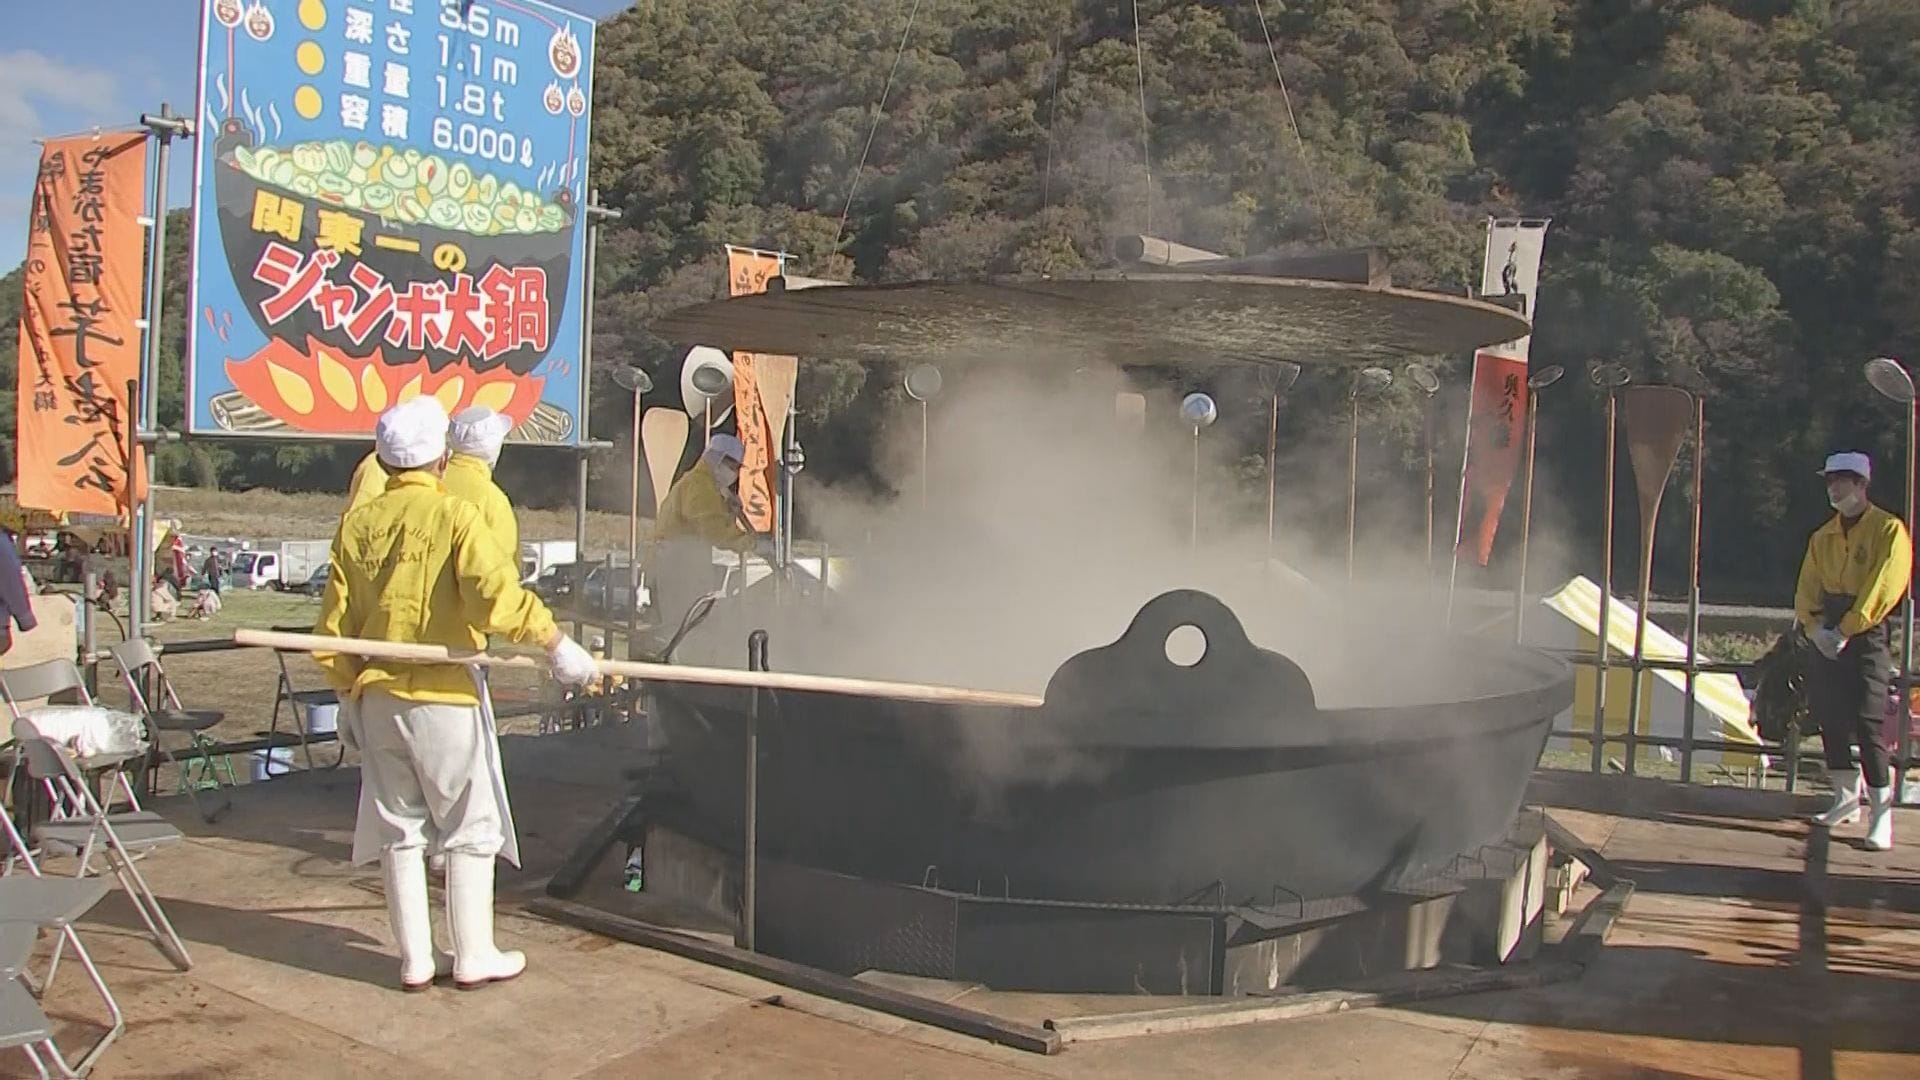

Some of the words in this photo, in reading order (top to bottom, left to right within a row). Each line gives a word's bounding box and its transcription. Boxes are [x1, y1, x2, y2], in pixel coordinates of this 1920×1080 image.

[345, 8, 411, 54] 深さ
[438, 35, 517, 85] 1.1m
[341, 94, 409, 139] 容積
[343, 51, 410, 98] 重量
[436, 75, 505, 121] 1.8t
[251, 189, 467, 272] 関東一の
[254, 242, 547, 360] ジャンボ大鍋
